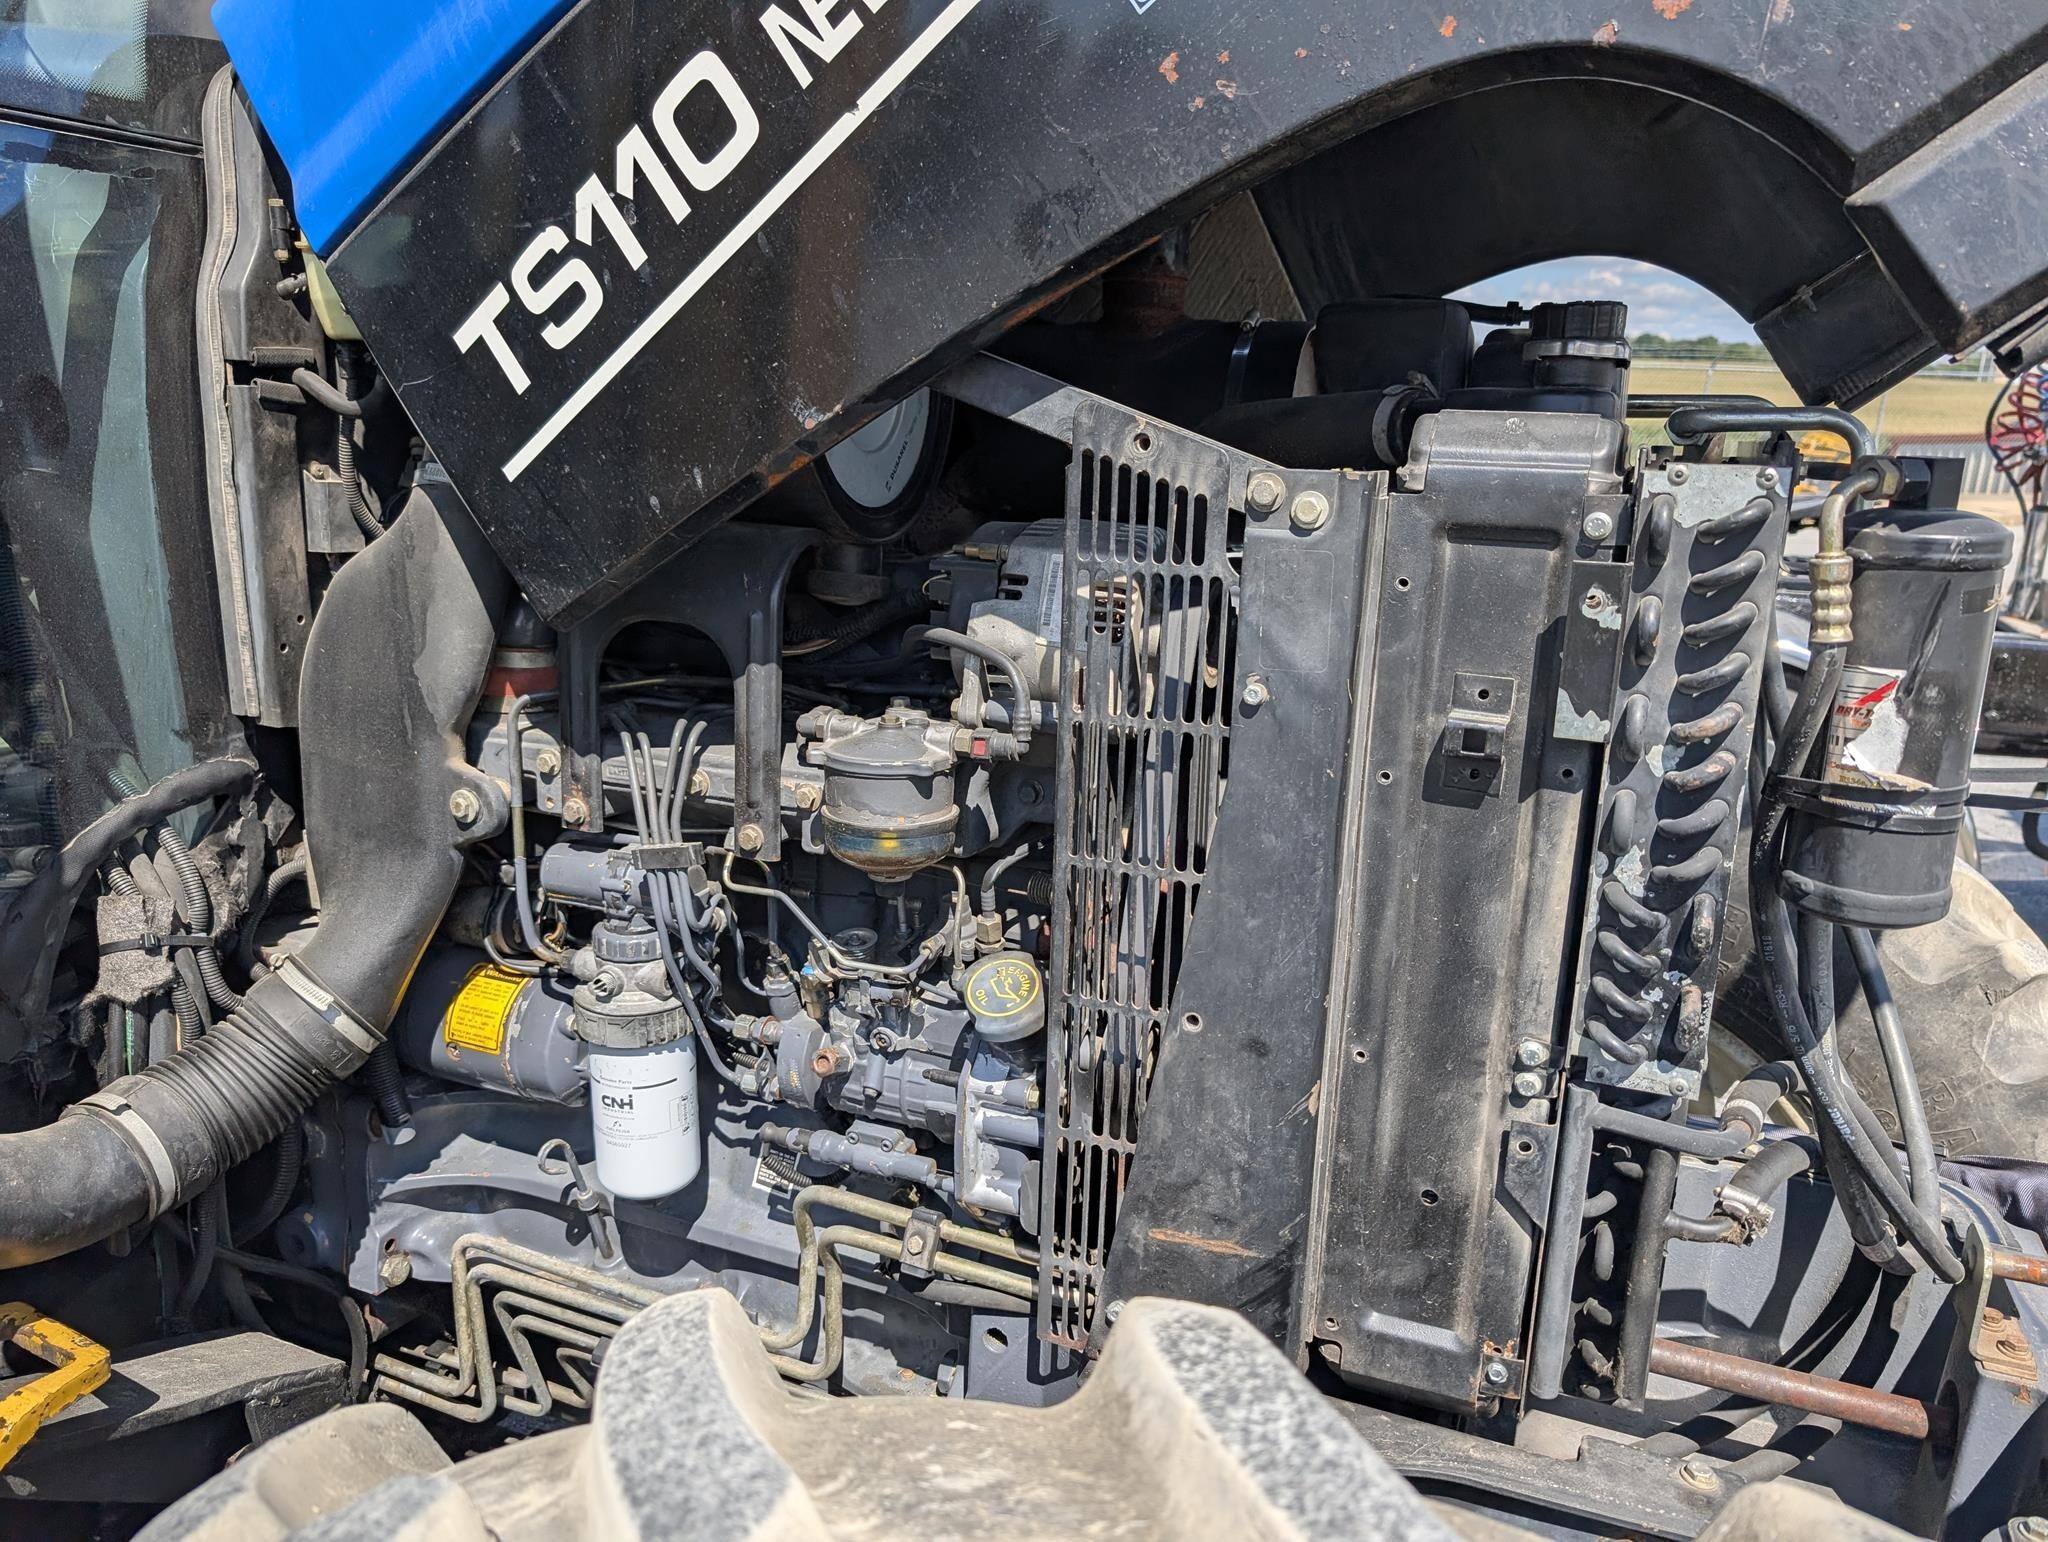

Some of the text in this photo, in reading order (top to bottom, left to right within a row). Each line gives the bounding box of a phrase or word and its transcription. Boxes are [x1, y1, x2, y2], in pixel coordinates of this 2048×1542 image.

[452, 0, 891, 395] TS110 NE
[975, 989, 989, 1006] OIL
[1007, 966, 1031, 998] ENGINE
